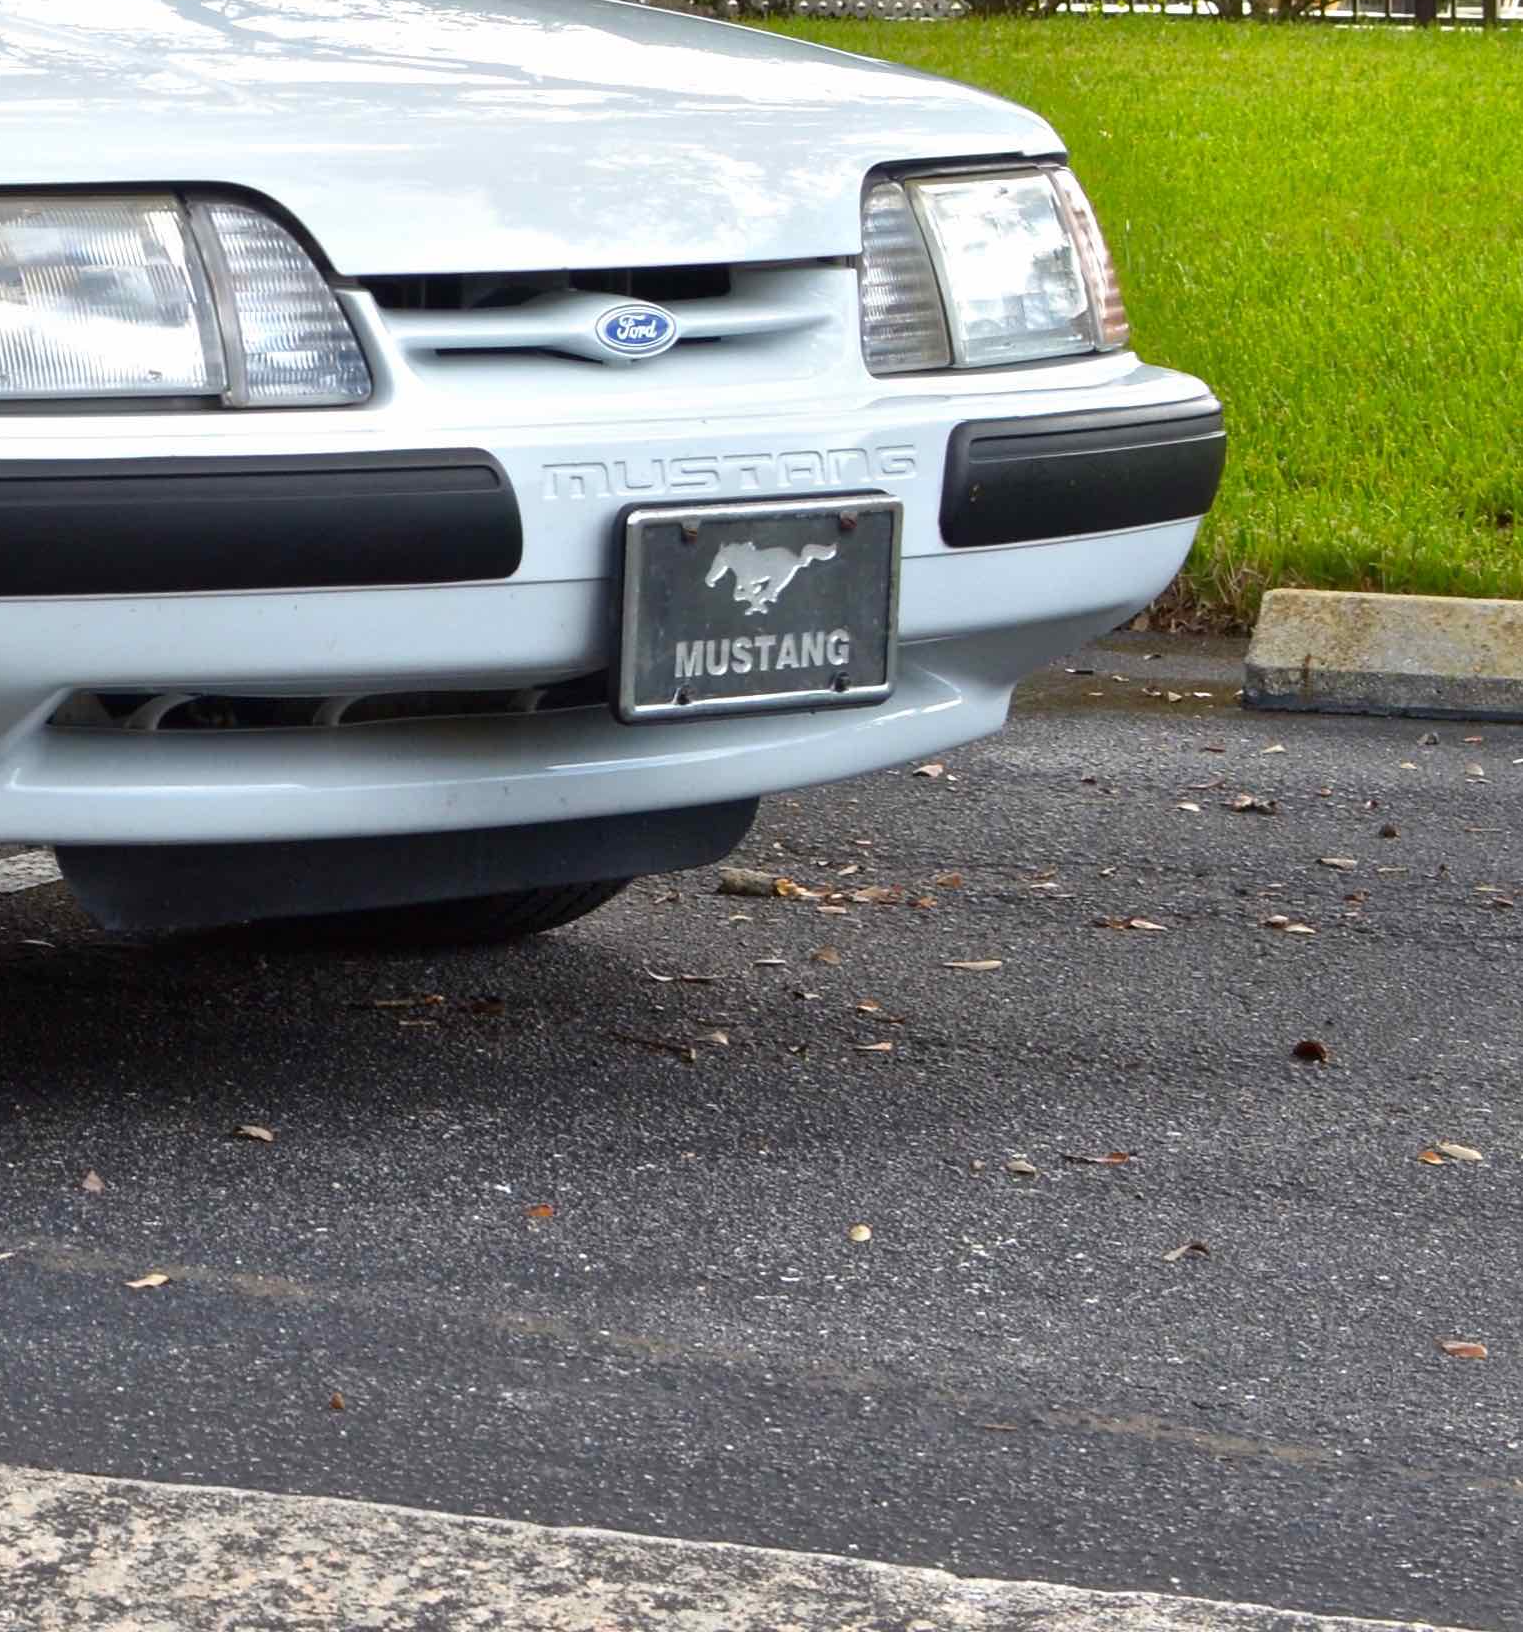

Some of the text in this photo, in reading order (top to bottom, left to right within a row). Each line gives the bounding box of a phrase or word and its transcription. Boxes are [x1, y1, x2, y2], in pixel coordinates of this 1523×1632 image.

[616, 314, 658, 340] Ford
[541, 443, 919, 500] MUSTANG
[674, 628, 850, 678] MUSTANG
